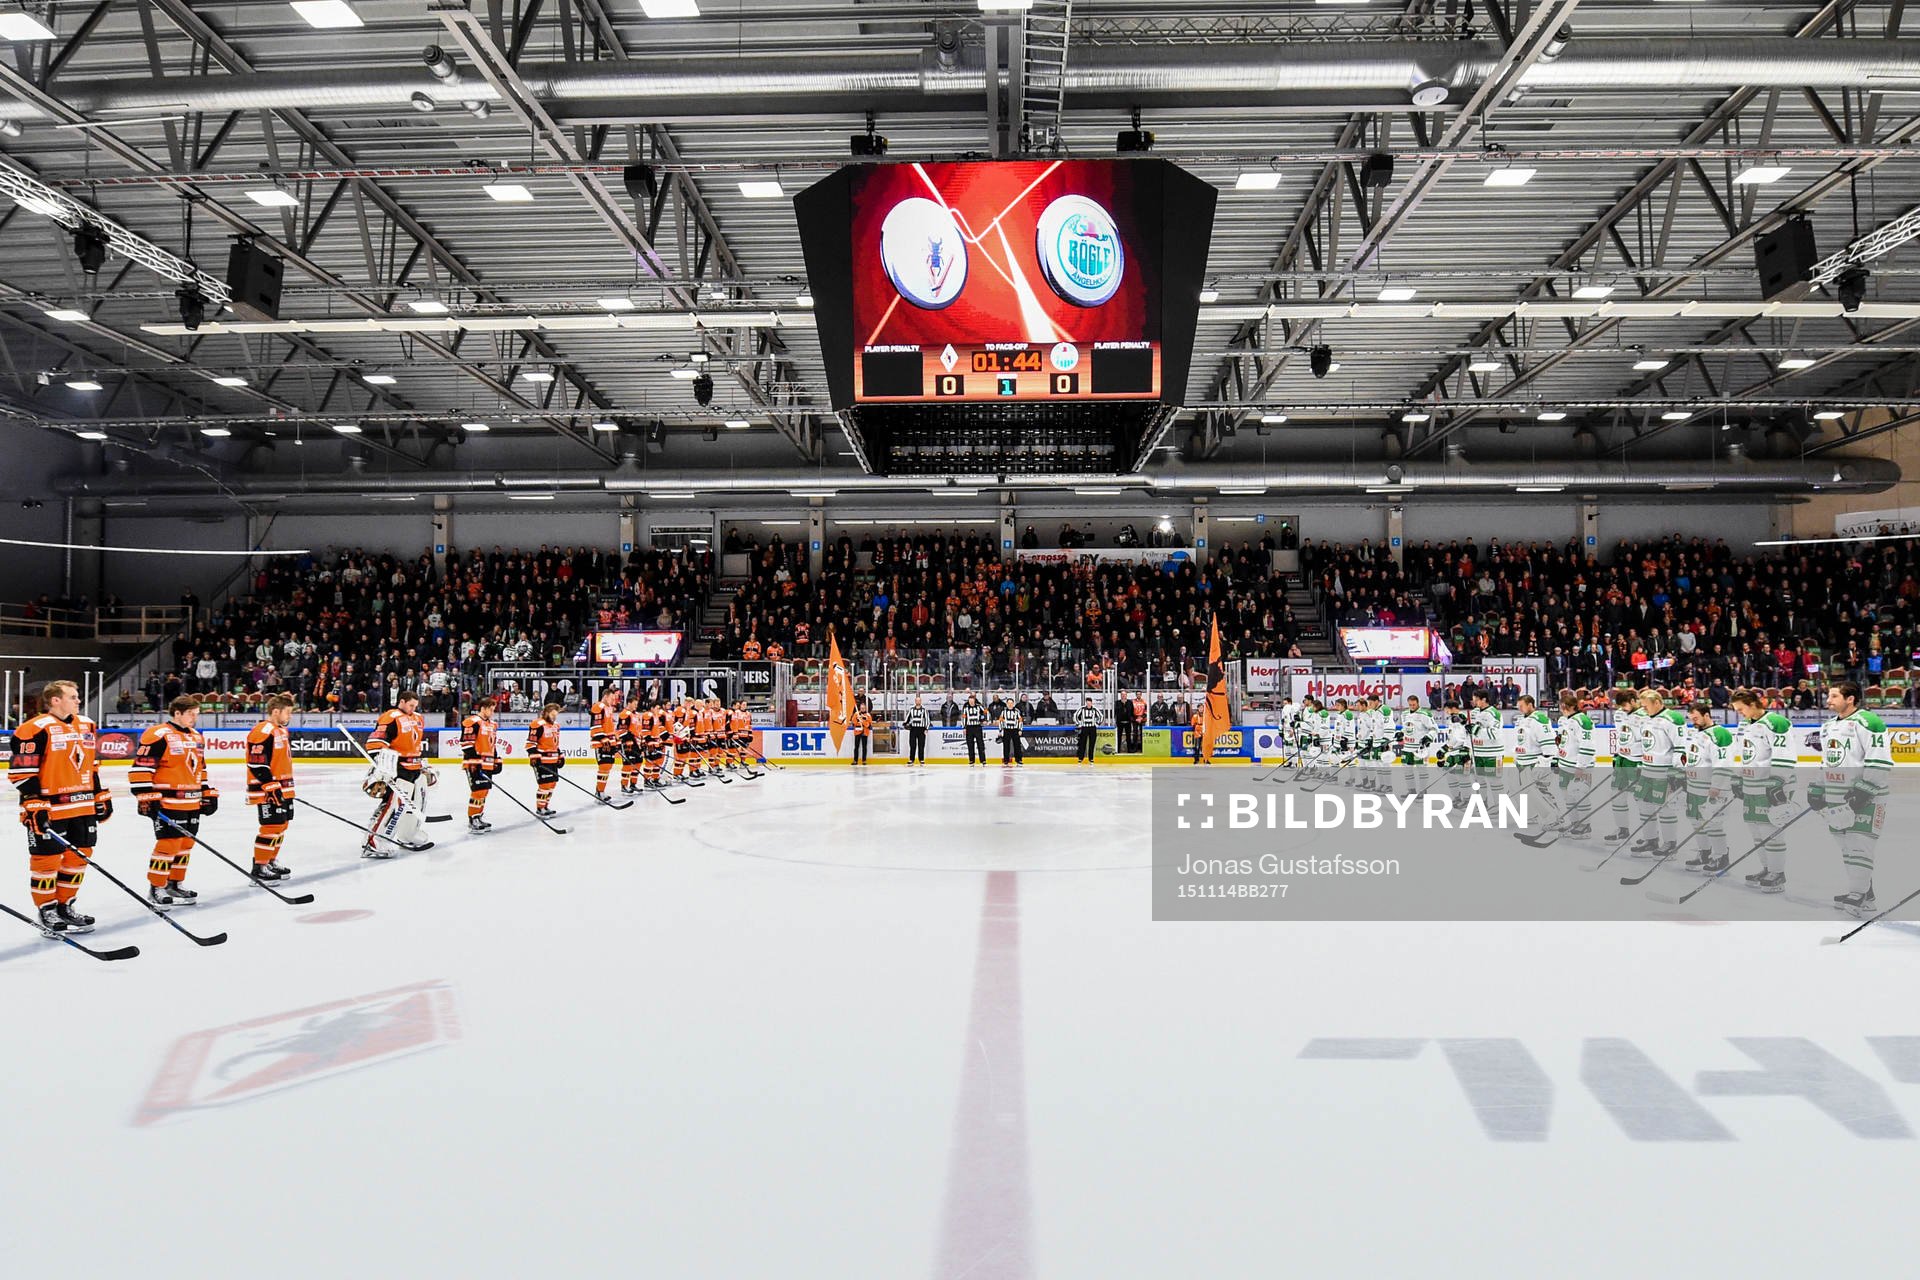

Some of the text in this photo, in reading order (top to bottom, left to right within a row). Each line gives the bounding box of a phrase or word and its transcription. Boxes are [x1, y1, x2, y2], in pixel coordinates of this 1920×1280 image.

[891, 344, 920, 352] PENALTY
[995, 343, 1028, 351] FACE-OFF
[1121, 341, 1150, 349] PENALTY
[973, 353, 1041, 370] 01:44
[943, 376, 957, 394] 0
[1002, 379, 1014, 394] 1
[1057, 375, 1070, 393] 0
[1306, 679, 1403, 700] Hemköp
[206, 738, 246, 750] Hem
[291, 738, 351, 752] stadium
[781, 733, 826, 751] BLT
[1034, 736, 1079, 745] WAHLQVIS
[1772, 735, 1787, 747] 22
[1844, 738, 1851, 750] A
[1871, 734, 1884, 747] 14
[20, 742, 36, 754] 19
[560, 745, 588, 757] avida
